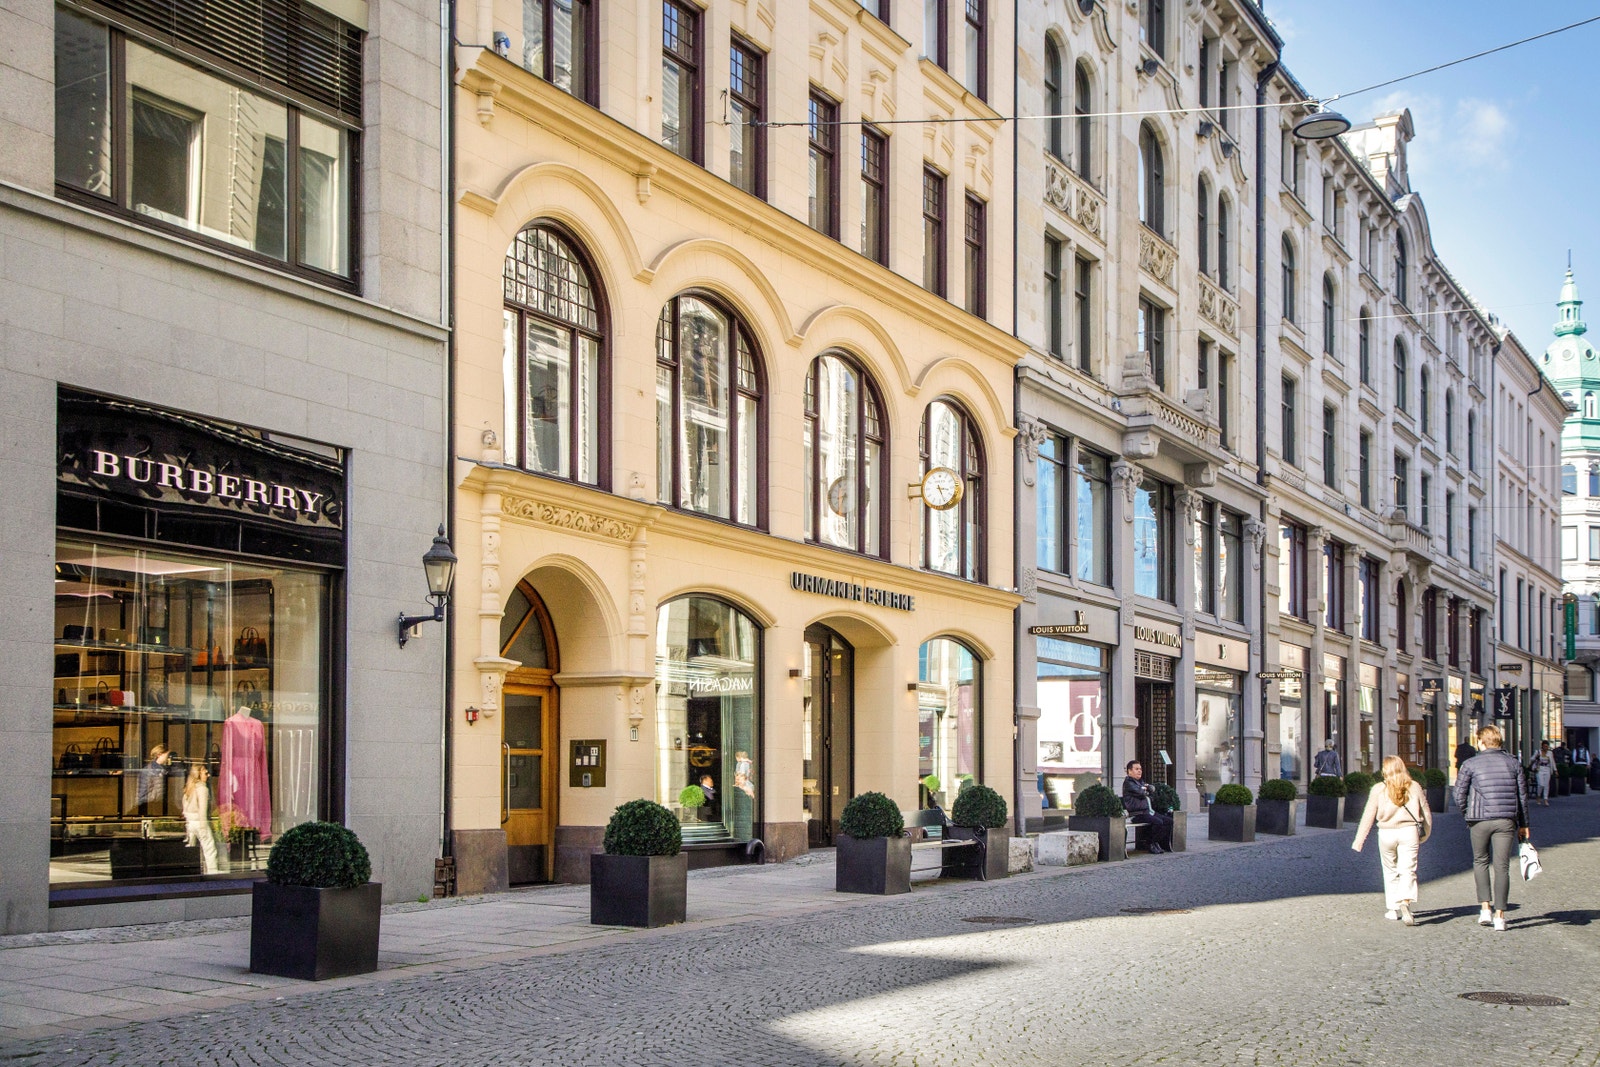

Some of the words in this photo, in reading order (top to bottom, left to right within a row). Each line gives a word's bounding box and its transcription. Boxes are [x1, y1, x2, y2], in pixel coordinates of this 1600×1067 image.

[93, 450, 323, 513] BURBERRY
[790, 572, 862, 601] URMAKER
[864, 587, 915, 611] BJERKE
[1055, 625, 1086, 633] VUITTON
[1137, 626, 1155, 643] LOUIS
[1156, 630, 1182, 648] VUITTON
